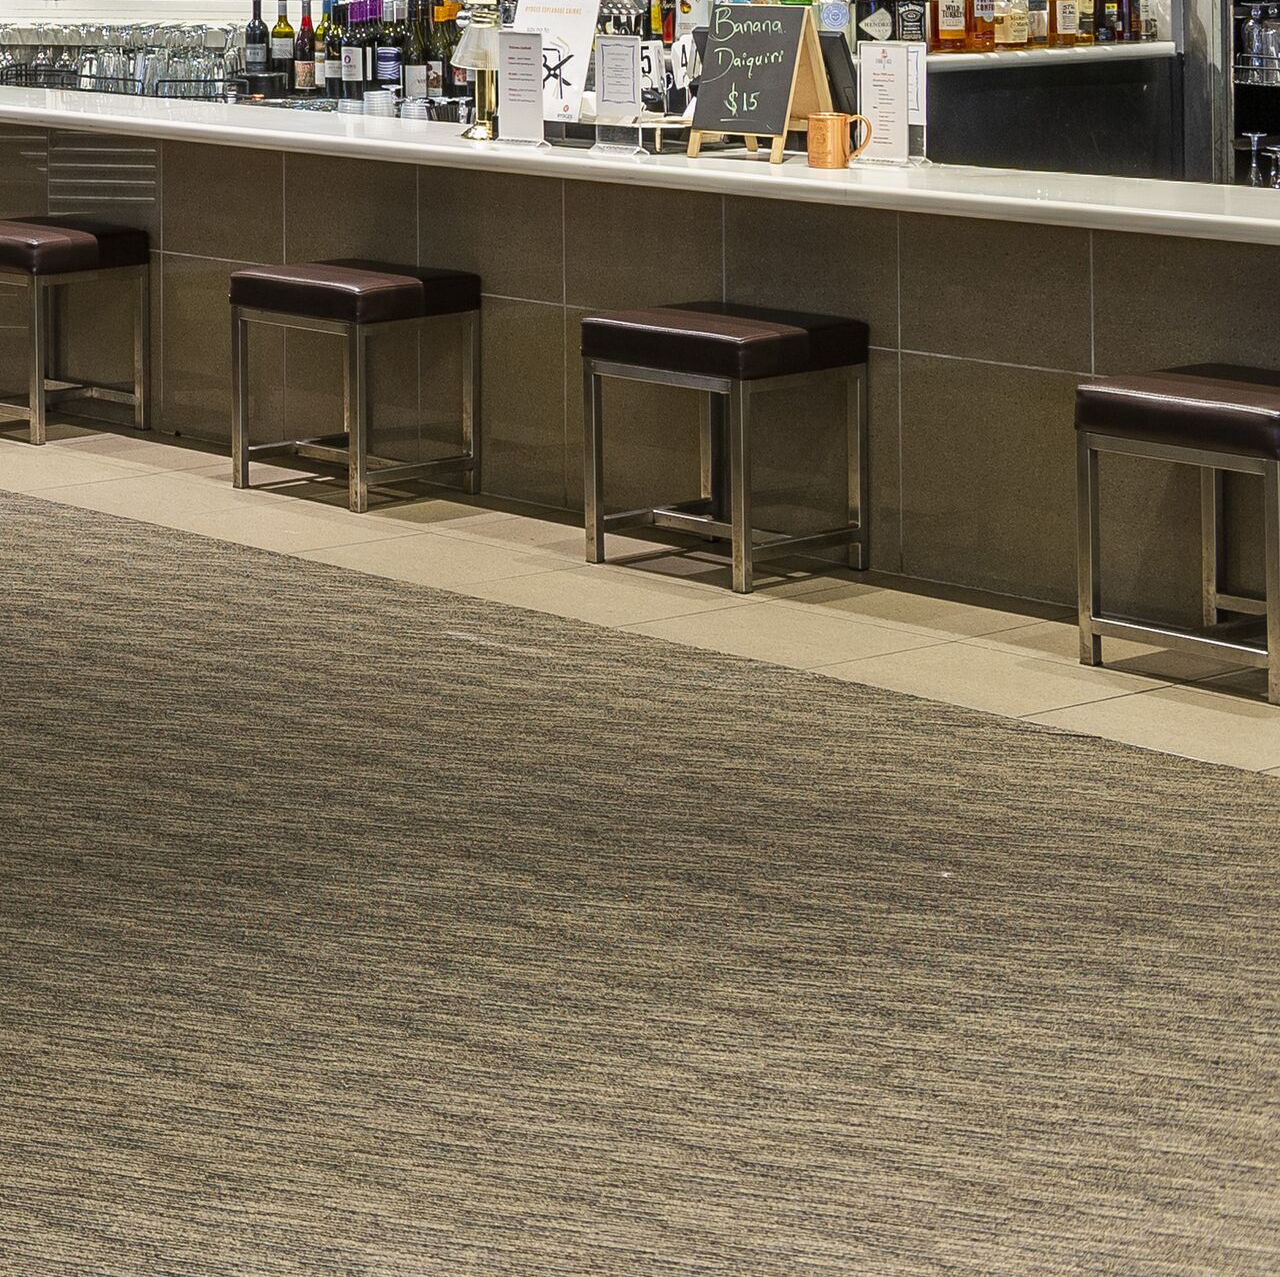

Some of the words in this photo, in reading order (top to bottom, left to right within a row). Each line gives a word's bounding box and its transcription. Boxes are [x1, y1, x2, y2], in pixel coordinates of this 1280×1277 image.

[708, 7, 783, 41] Banana
[641, 46, 651, 74] 5
[681, 44, 688, 67] 4
[702, 47, 784, 83] Daiquiri
[723, 82, 760, 117] $15
